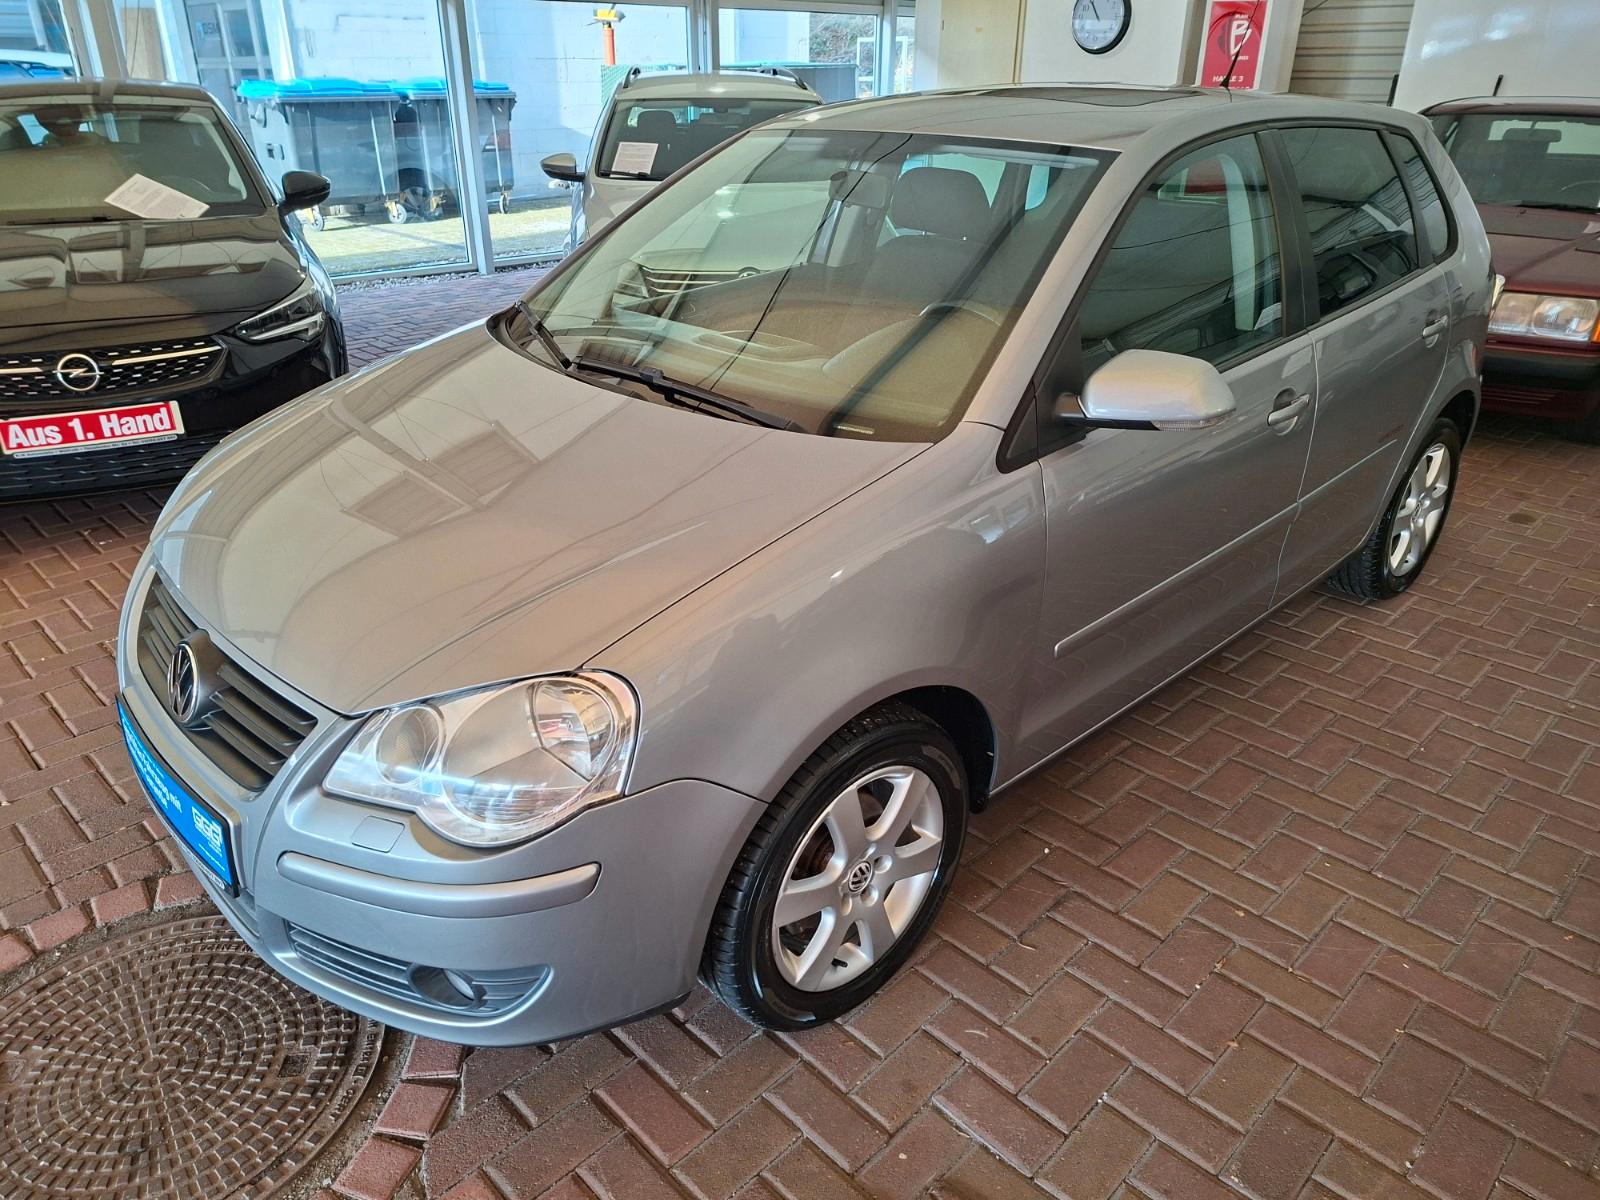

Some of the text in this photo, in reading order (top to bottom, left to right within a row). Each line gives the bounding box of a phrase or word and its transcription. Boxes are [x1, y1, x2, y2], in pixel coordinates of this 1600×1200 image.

[8, 424, 63, 449] Aus
[68, 418, 96, 441] 1.
[99, 407, 172, 437] Hand
